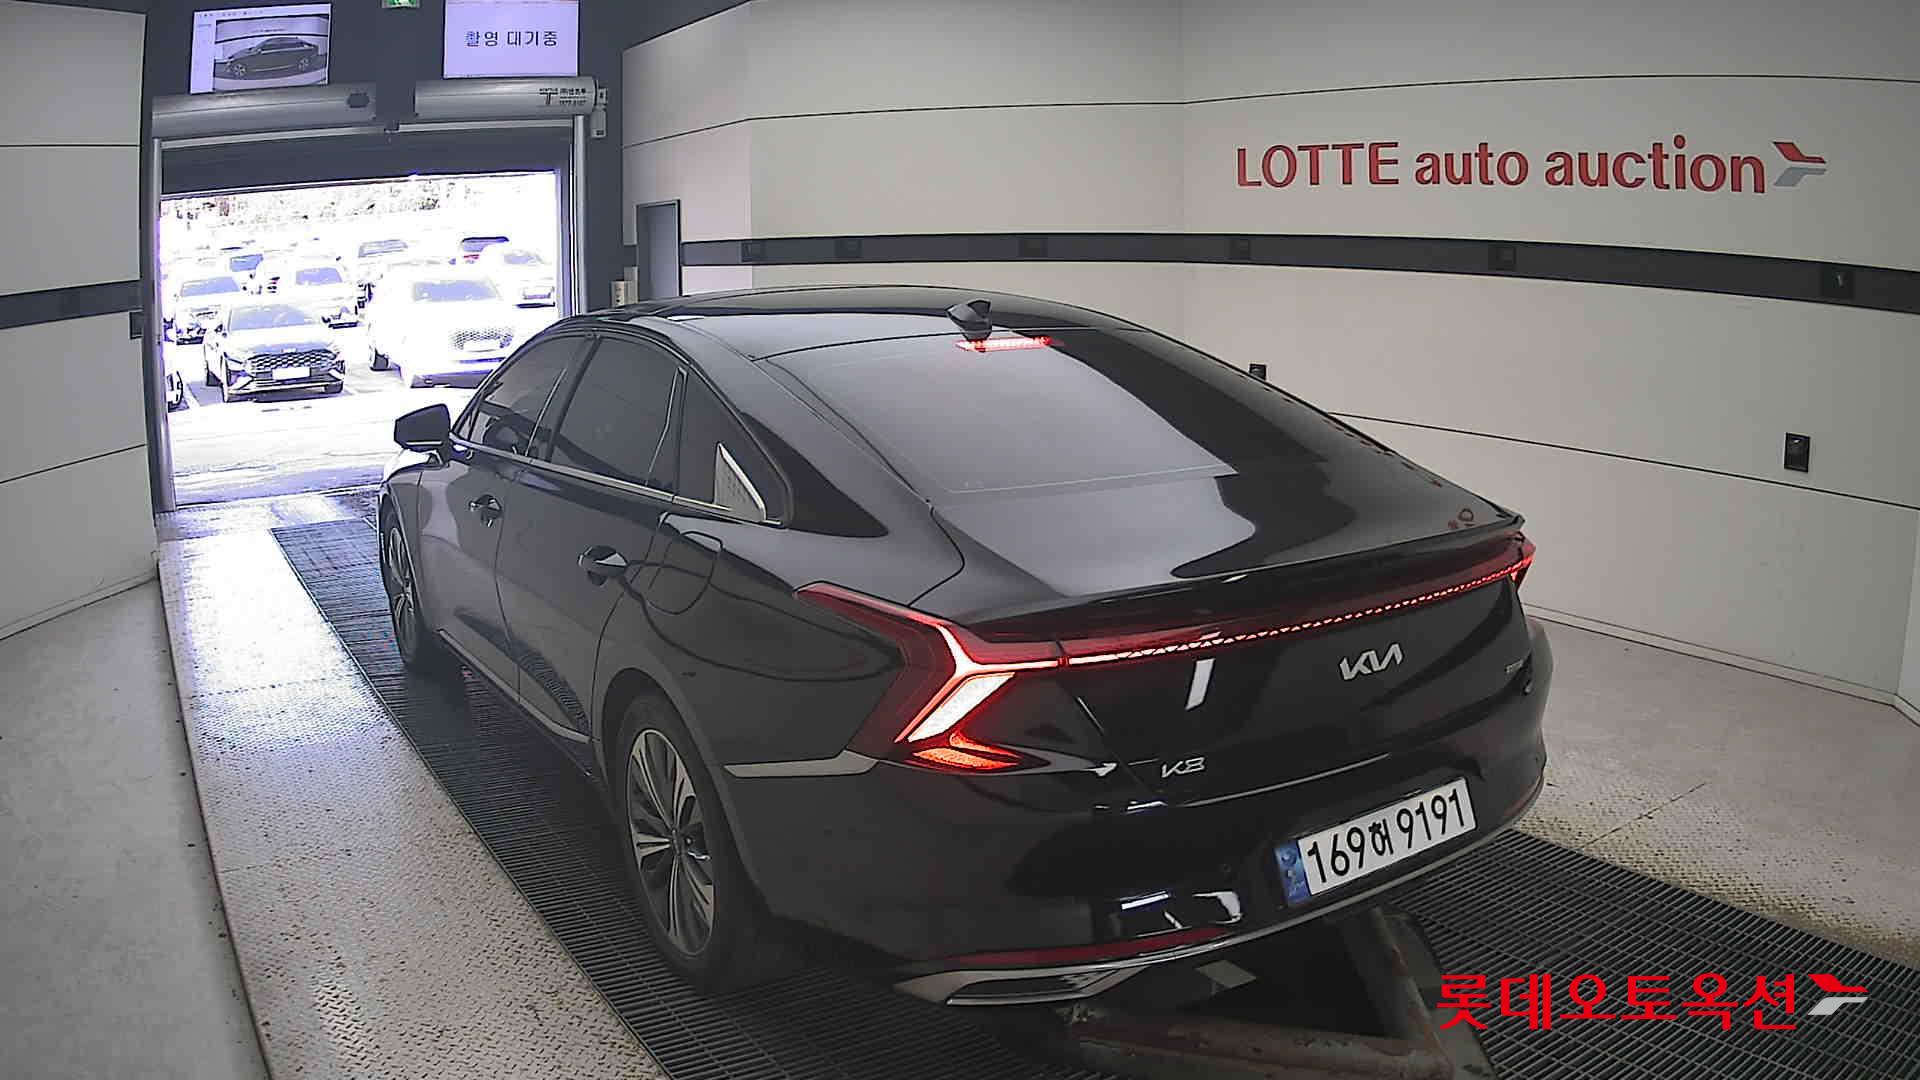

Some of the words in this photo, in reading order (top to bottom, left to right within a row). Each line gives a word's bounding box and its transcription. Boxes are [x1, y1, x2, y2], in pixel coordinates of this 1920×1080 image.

[507, 31, 557, 47] 대기중
[1236, 141, 1400, 188] LOTTE
[1415, 142, 1529, 186] auto
[1544, 134, 1766, 194] auction
[1339, 643, 1404, 681] KIA
[1161, 757, 1205, 778] K8
[1307, 818, 1394, 884] 169허
[1396, 788, 1465, 849] 9191
